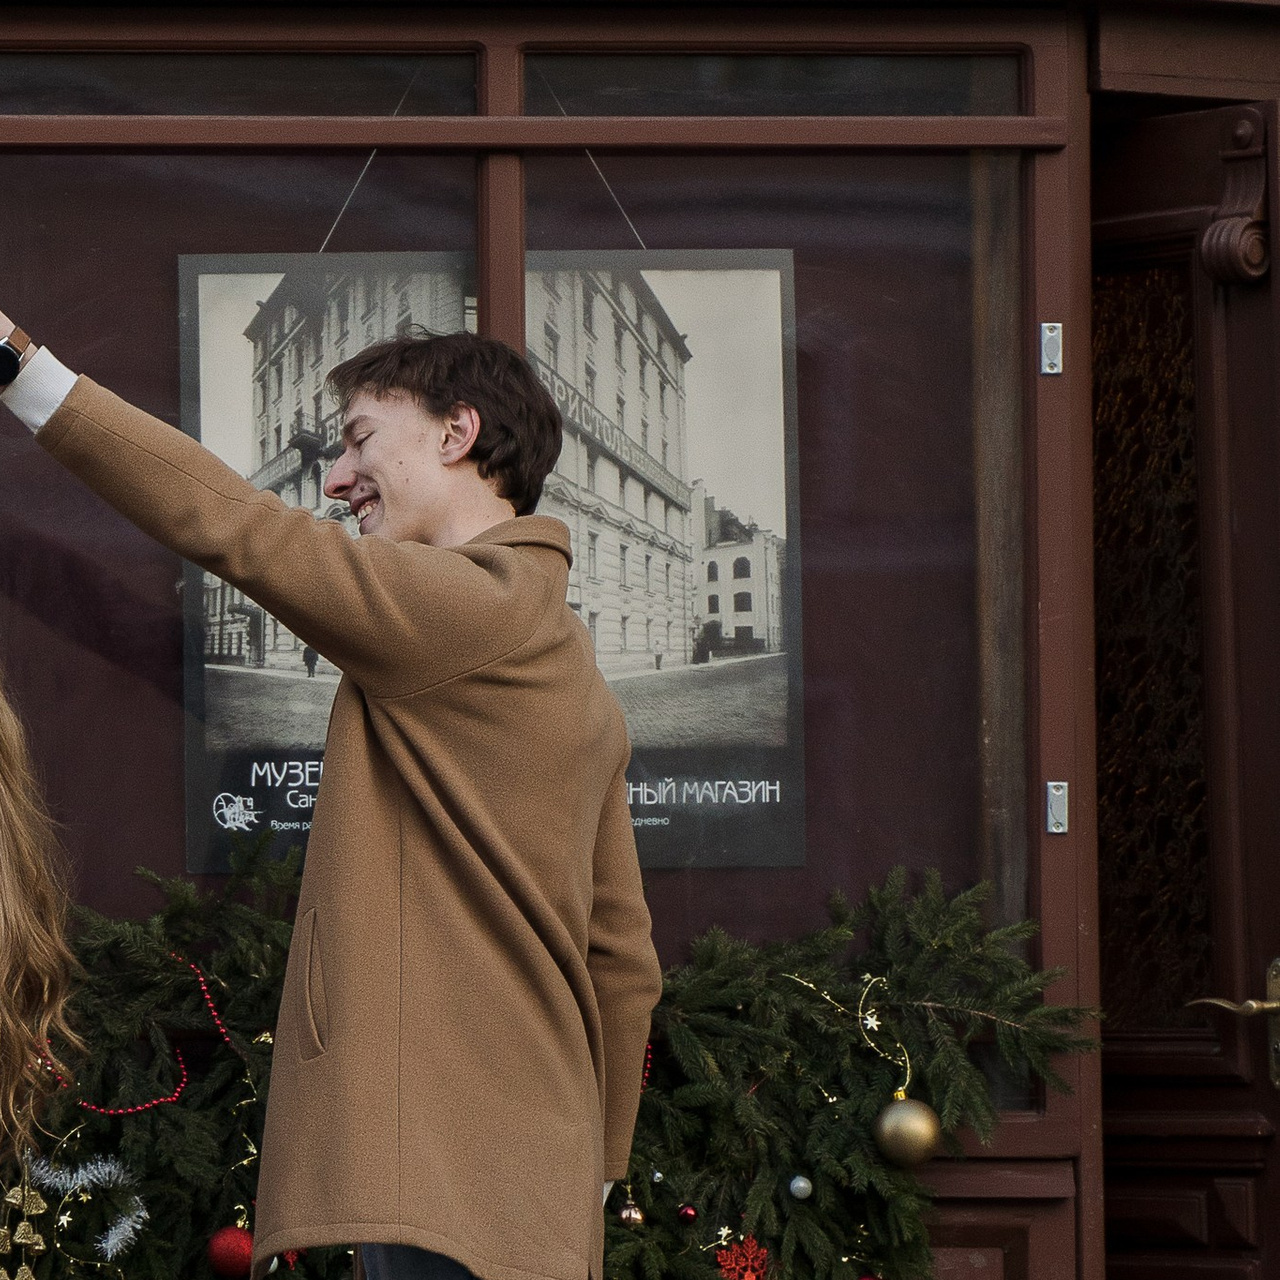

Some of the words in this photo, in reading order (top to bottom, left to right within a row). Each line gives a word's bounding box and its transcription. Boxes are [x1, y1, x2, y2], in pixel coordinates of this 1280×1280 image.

[626, 777, 676, 805] НЫЙ
[682, 780, 781, 804] МАГАЗИН
[270, 820, 300, 832] Время
